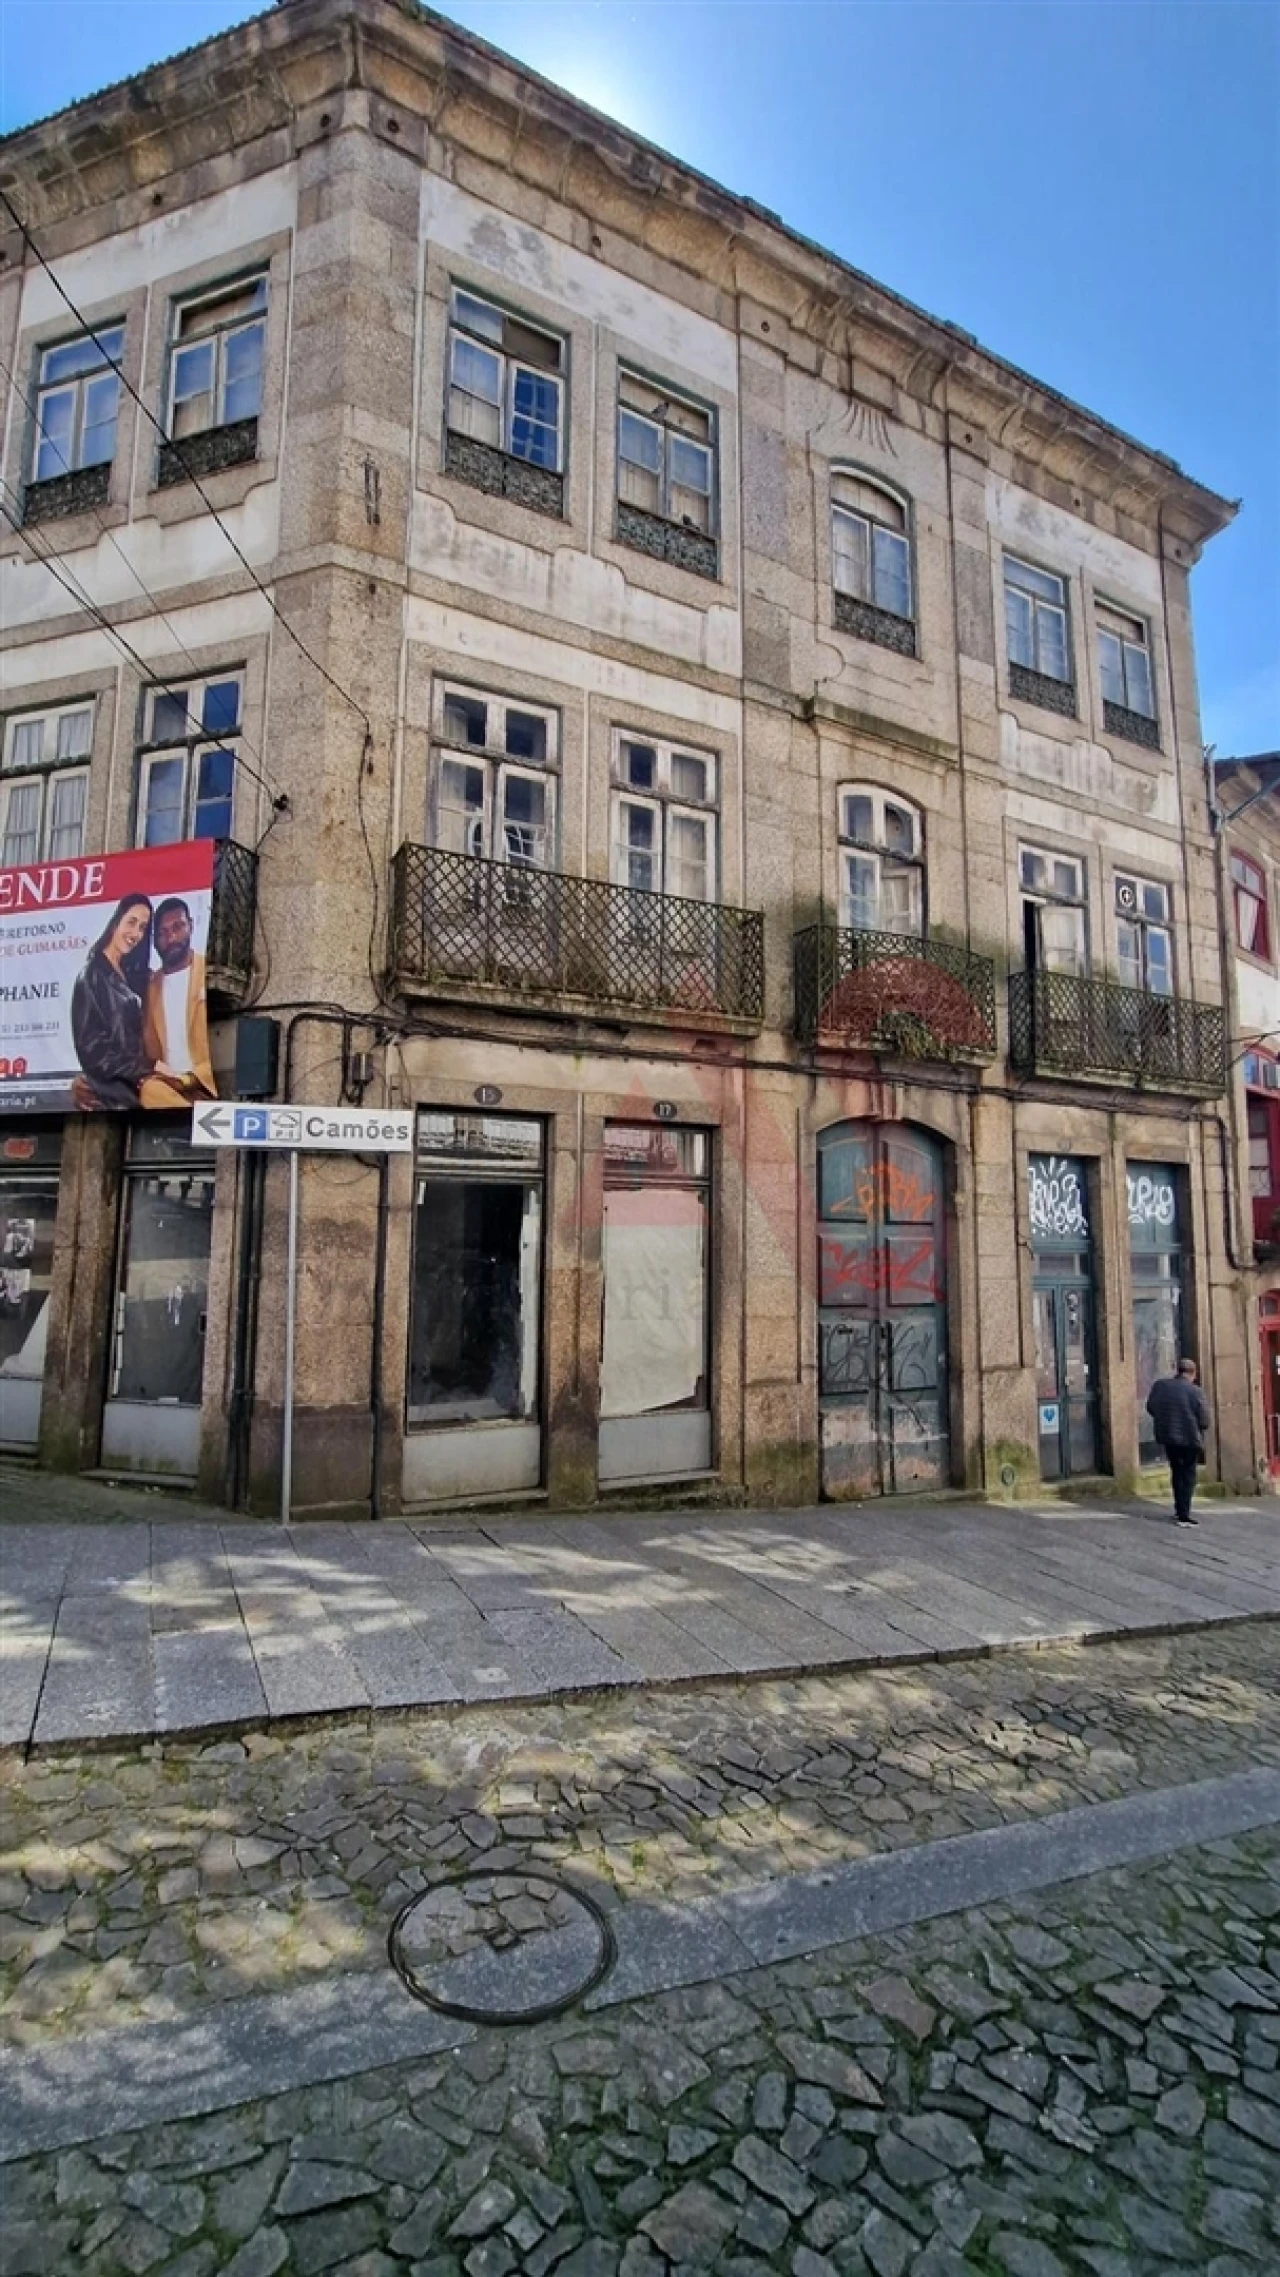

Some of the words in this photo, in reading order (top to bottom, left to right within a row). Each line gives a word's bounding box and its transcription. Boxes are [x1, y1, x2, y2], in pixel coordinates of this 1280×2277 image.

[0, 862, 106, 908] ENDE
[17, 935, 88, 956] GUIMARÃES
[659, 1104, 672, 1116] 17
[243, 1116, 260, 1138] P
[305, 1116, 409, 1140] Camões
